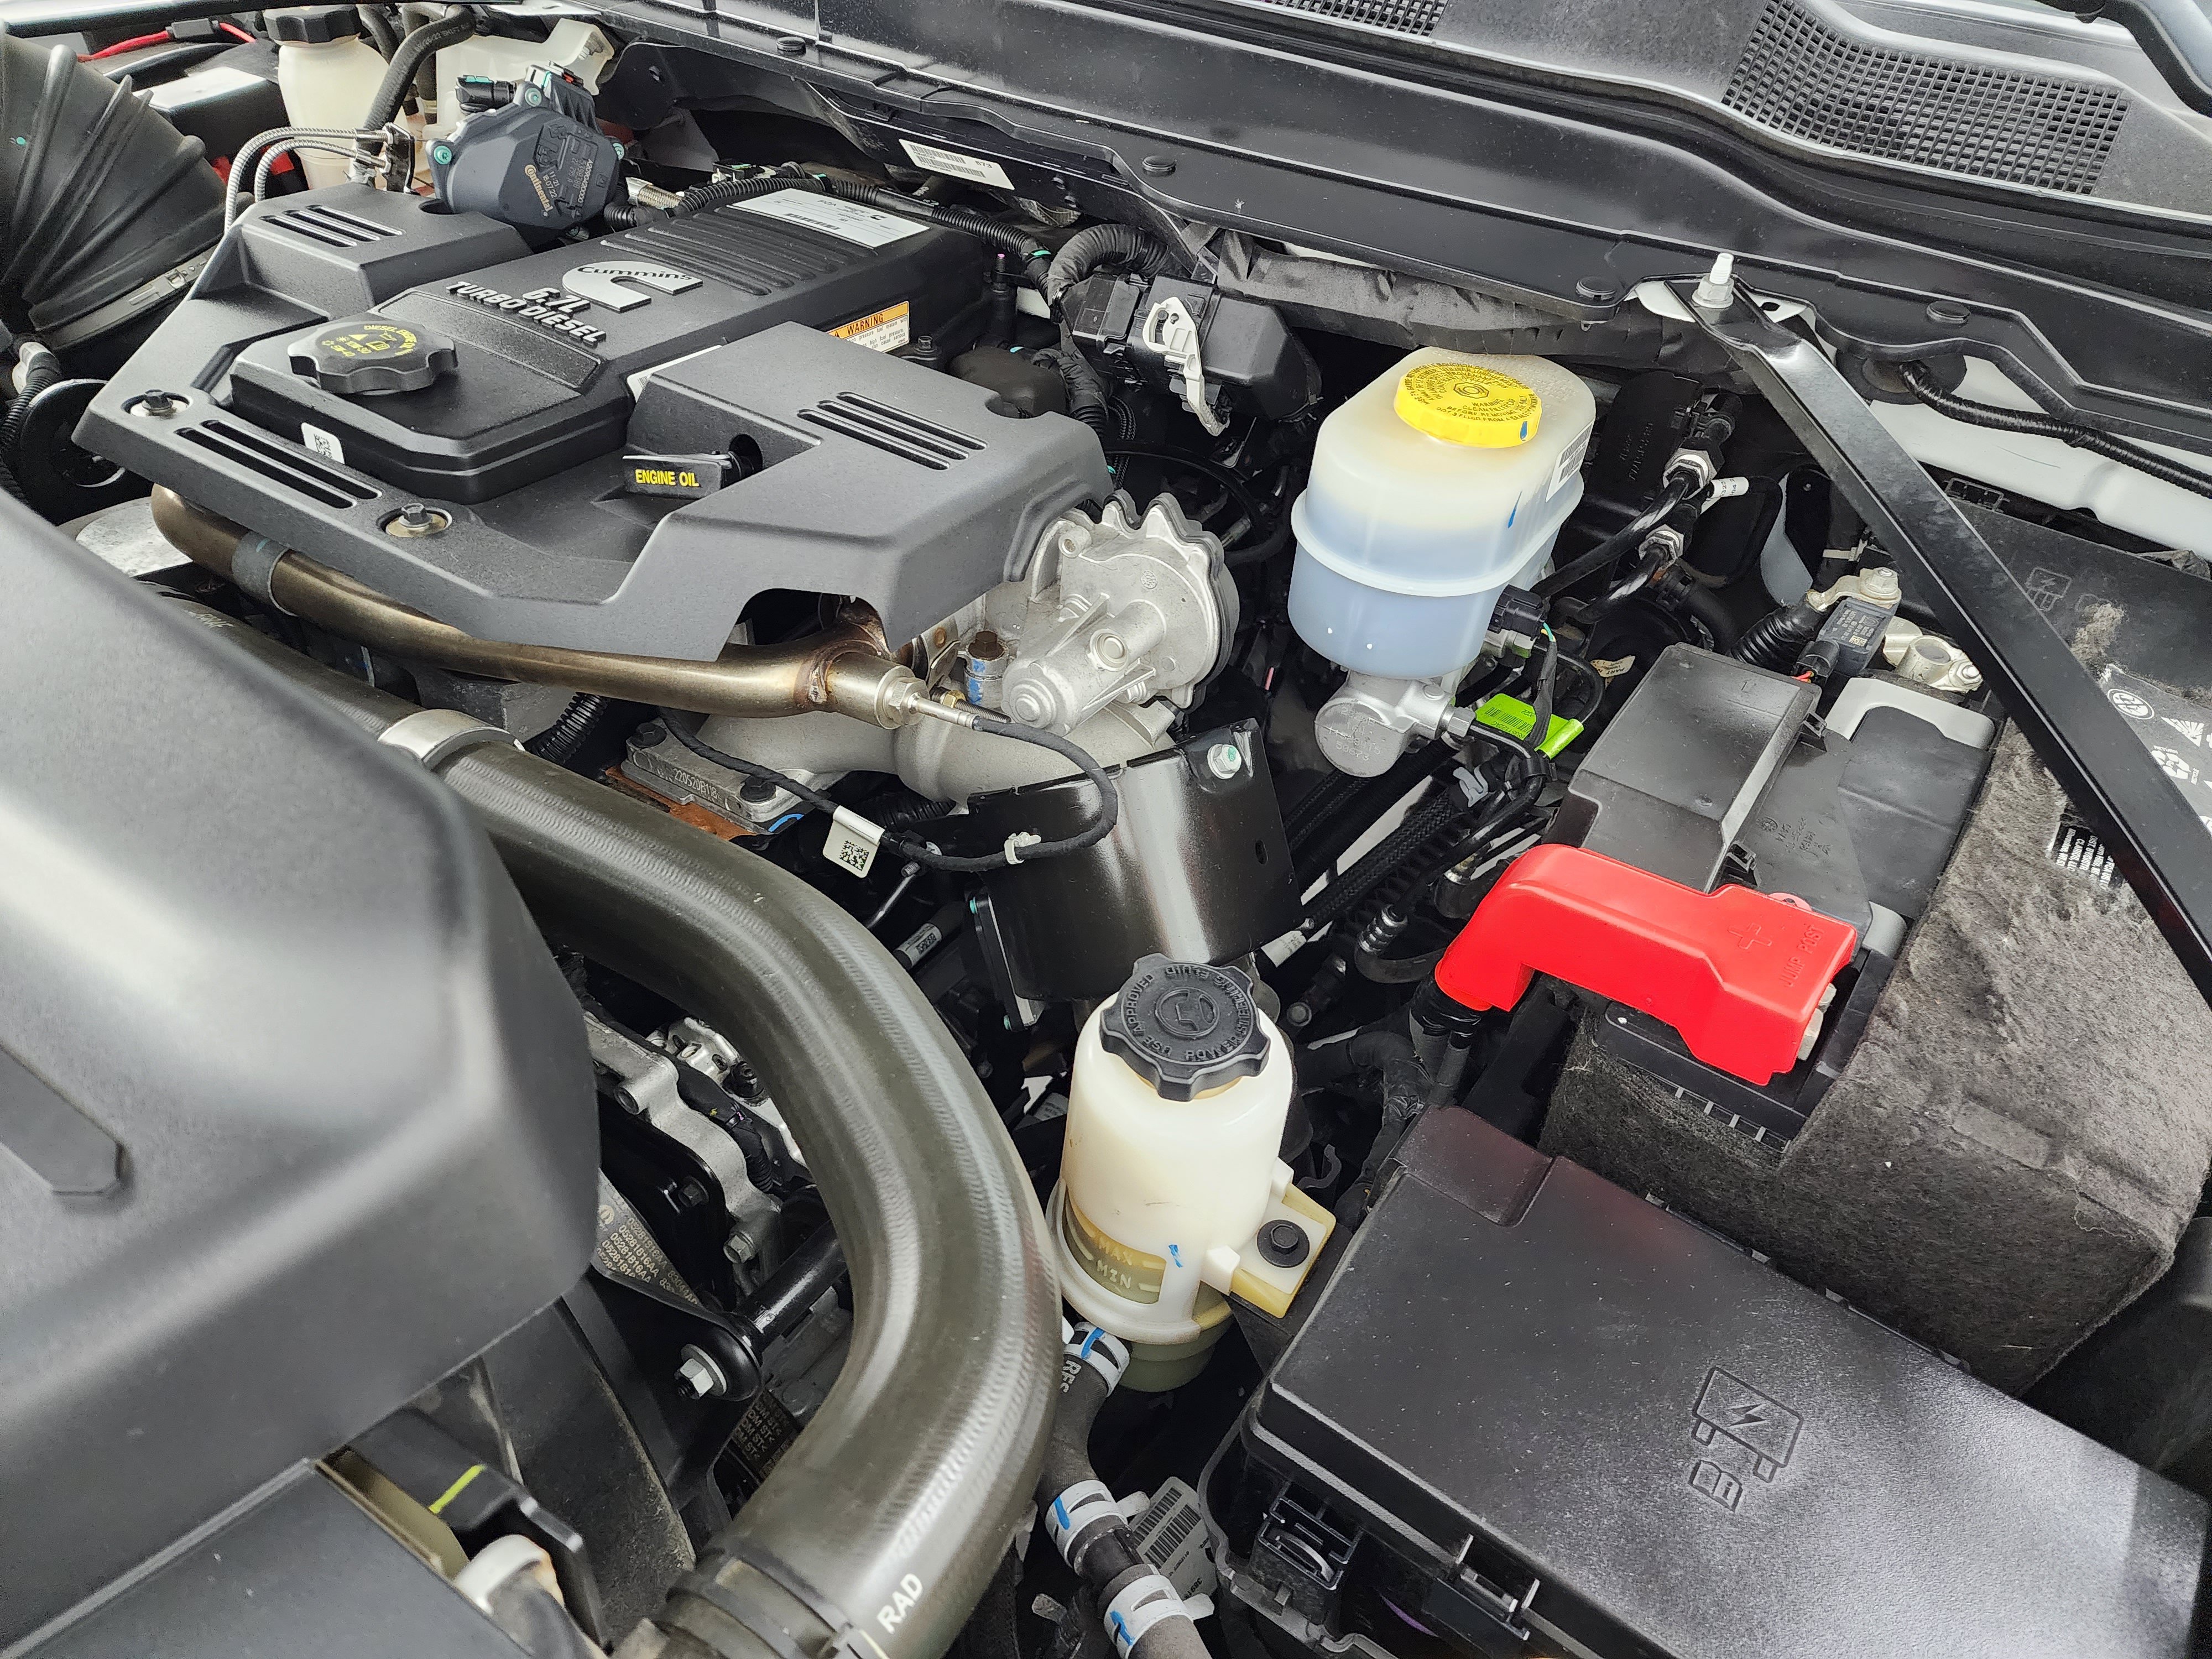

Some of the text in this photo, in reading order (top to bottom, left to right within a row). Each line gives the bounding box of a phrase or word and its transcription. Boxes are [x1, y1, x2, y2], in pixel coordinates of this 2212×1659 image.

[524, 164, 553, 212] Continental
[577, 266, 692, 280] Cummins
[446, 281, 607, 347] TURBO DIESEL
[521, 287, 591, 315] 6.7L
[847, 313, 884, 336] WARNING
[1447, 406, 1477, 415] BEFORE
[635, 469, 700, 487] ENGINE OIL
[2069, 838, 2085, 862] CLARIOS,
[1778, 924, 1824, 988] JUMP POST
[1126, 973, 1173, 1057] USE APPROVED
[1164, 965, 1250, 1061] POWER STEERING FLUID
[1099, 1237, 1133, 1266] MAX
[1097, 1259, 1131, 1289] MIN
[877, 1573, 923, 1635] RAD
